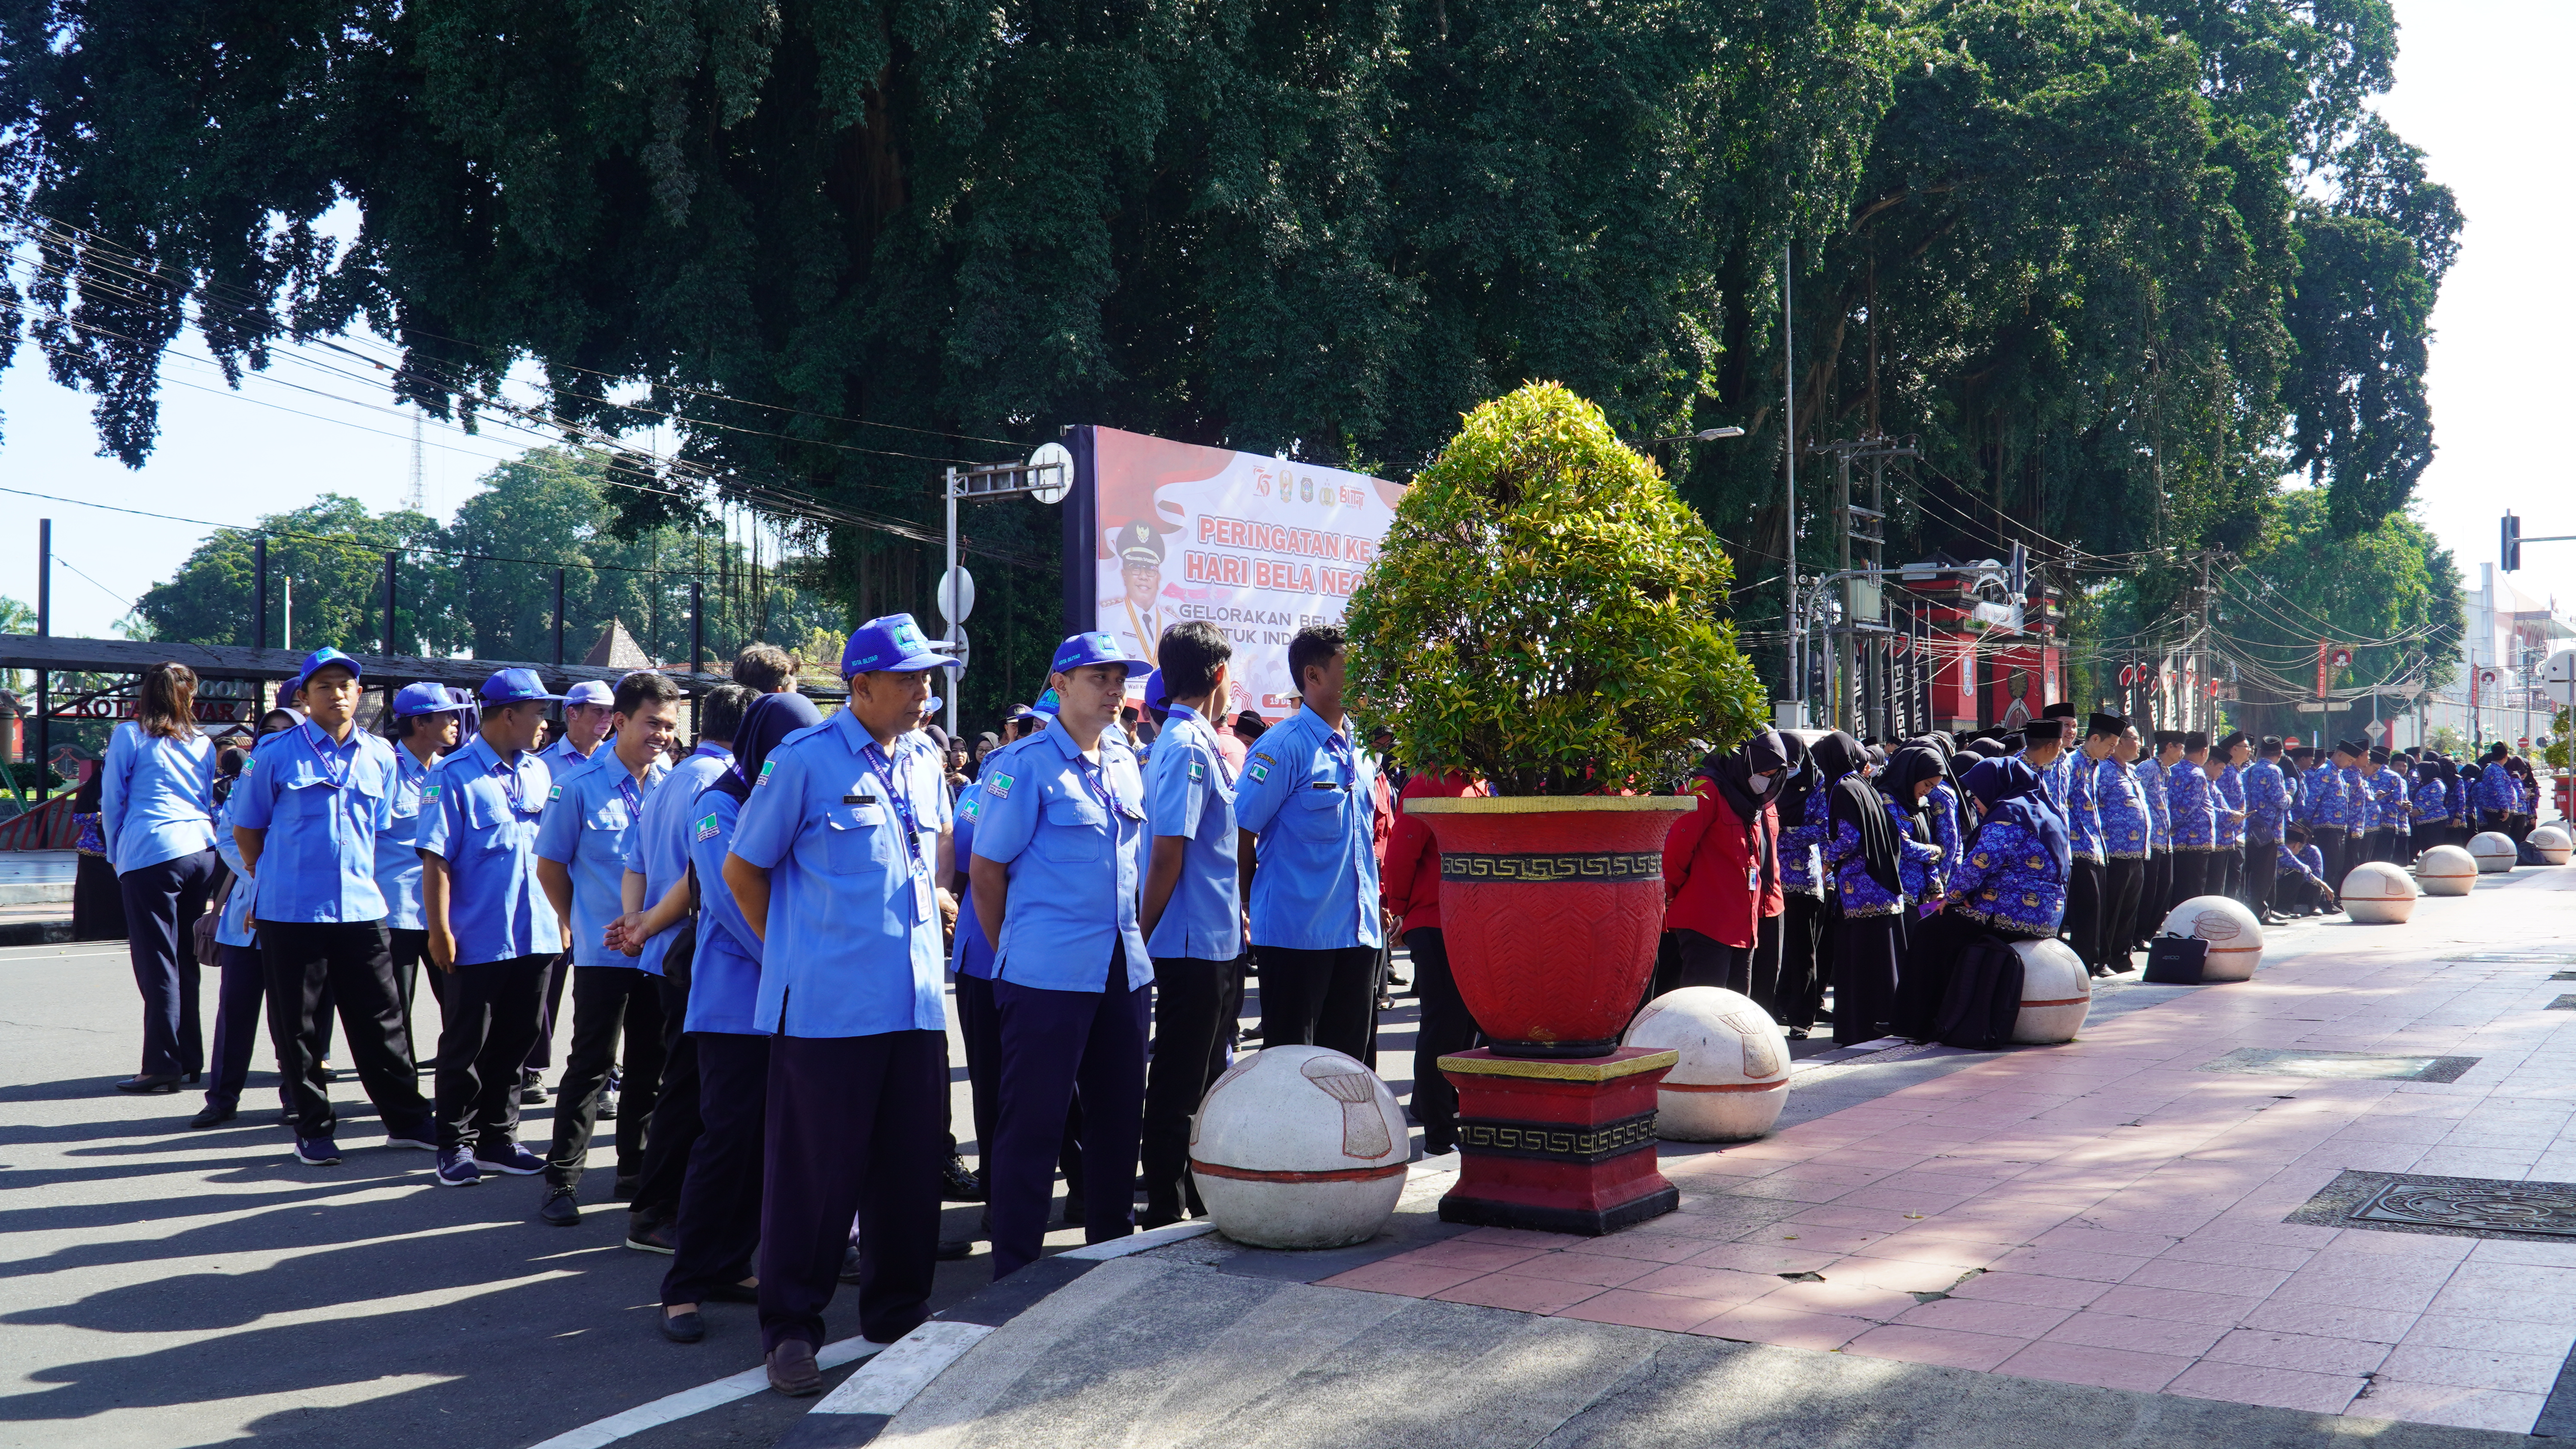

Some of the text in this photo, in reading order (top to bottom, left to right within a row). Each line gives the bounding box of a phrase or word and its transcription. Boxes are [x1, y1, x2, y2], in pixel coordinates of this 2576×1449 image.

[1199, 516, 1339, 559] PERINGATAN
[1345, 537, 1372, 563] KE
[1186, 552, 1249, 585] HARI
[1255, 561, 1315, 593] BELA
[1179, 604, 1291, 626] GELORAKAN
[1222, 628, 1257, 644] TUK
[863, 655, 878, 664] BLITAR
[1067, 654, 1081, 664] BLITAR
[1912, 667, 1923, 731] POLYG
